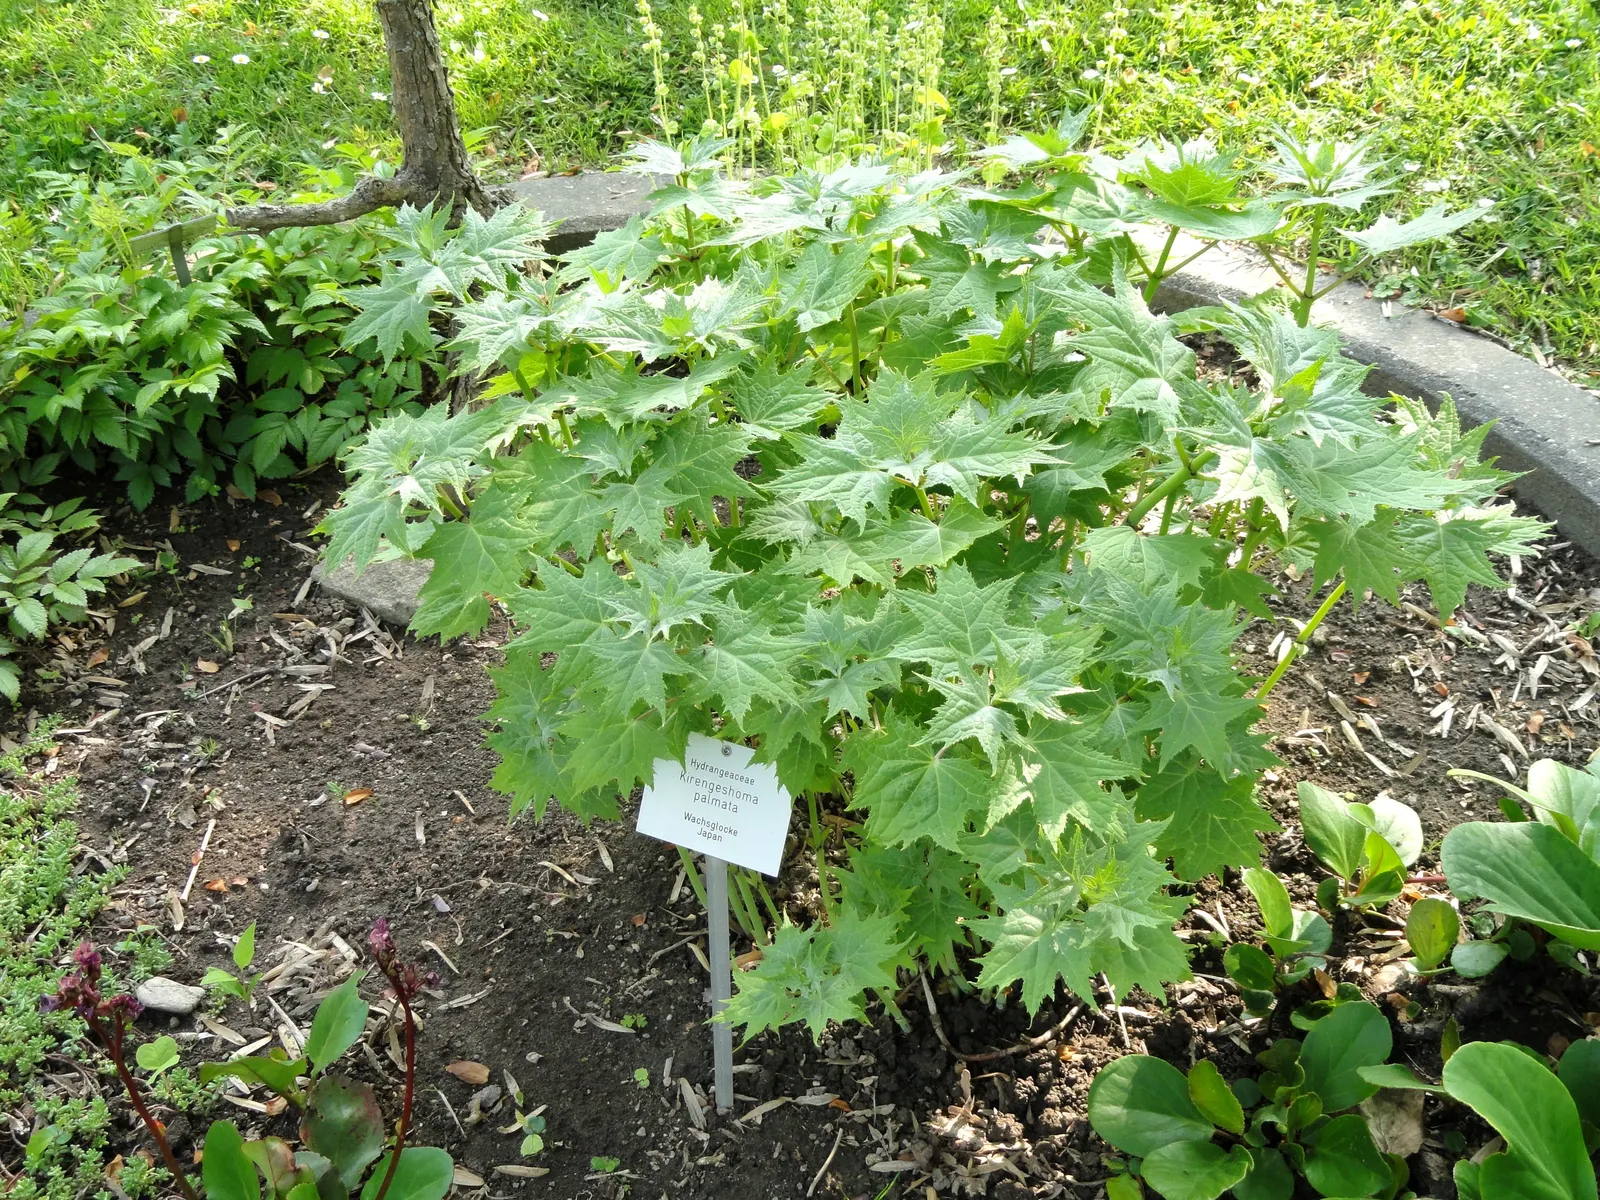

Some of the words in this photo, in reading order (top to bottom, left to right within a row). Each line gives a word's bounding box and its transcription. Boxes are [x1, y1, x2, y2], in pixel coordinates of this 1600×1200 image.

[690, 758, 755, 786] Hydrangeaceae
[679, 771, 759, 805] Kirengeshoma
[693, 791, 739, 813] palmata
[684, 811, 739, 837] Wachsglocke
[696, 828, 723, 842] Japan
